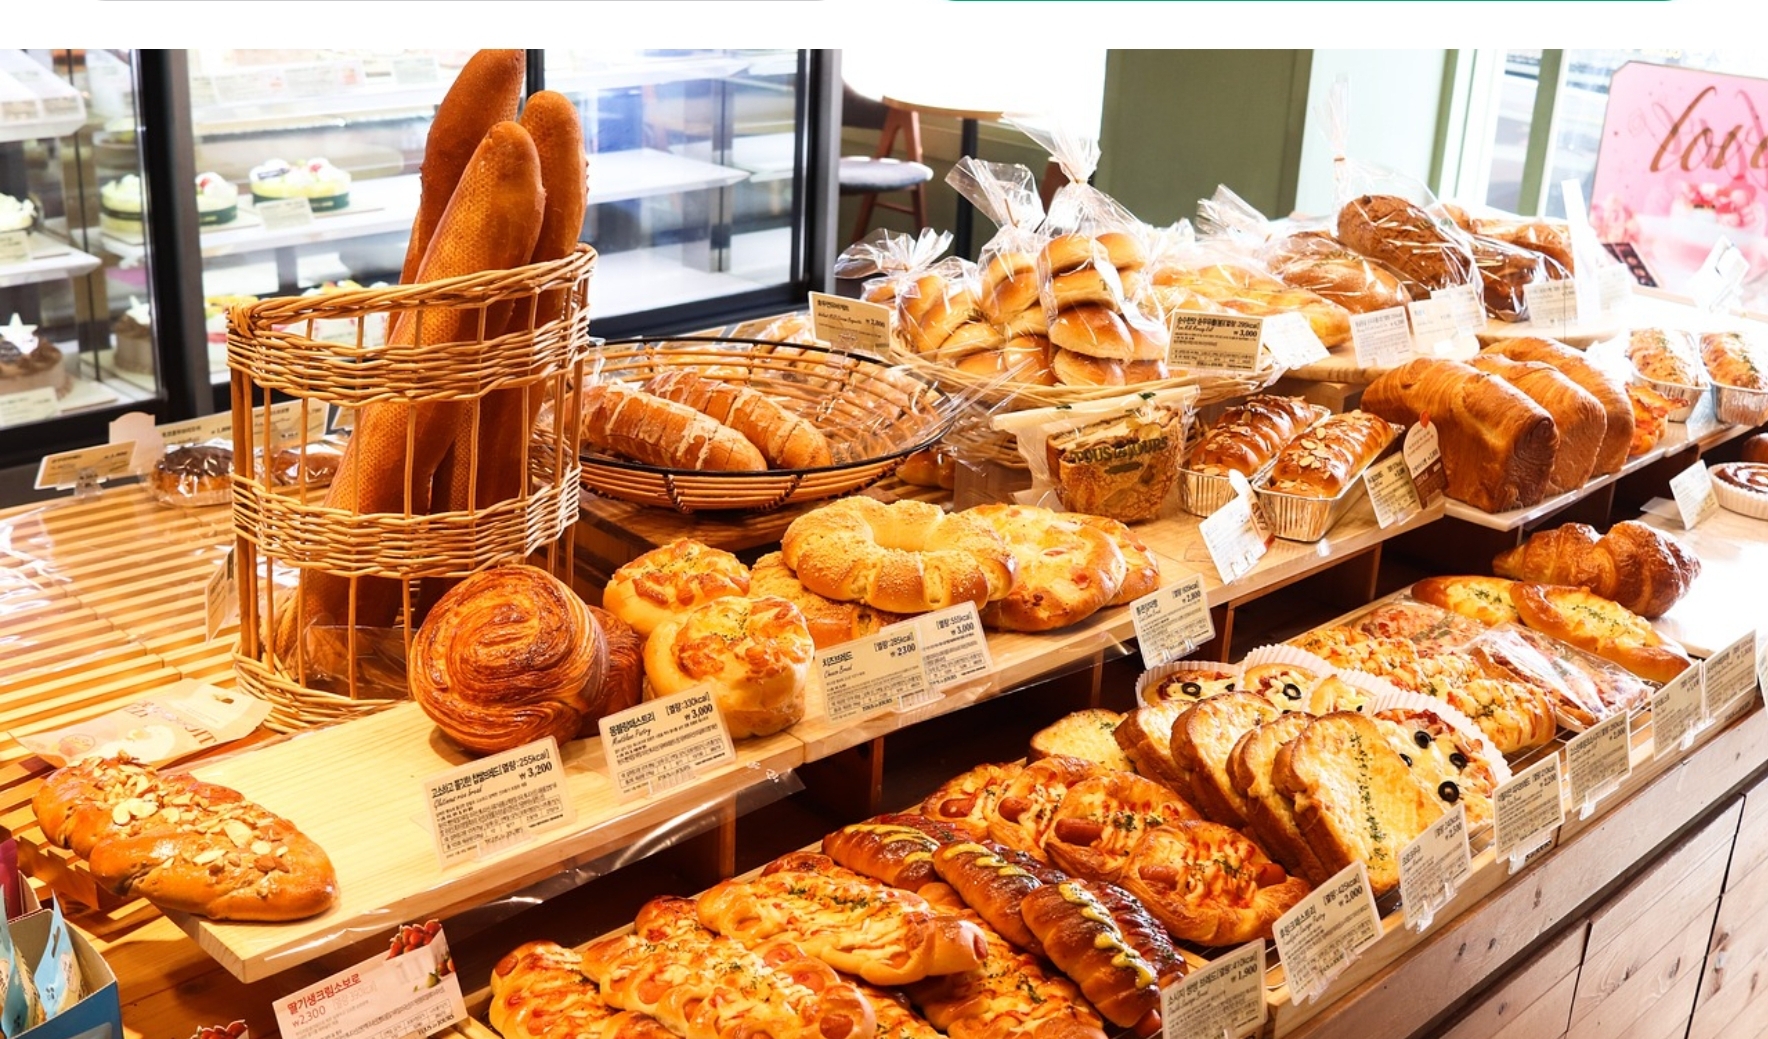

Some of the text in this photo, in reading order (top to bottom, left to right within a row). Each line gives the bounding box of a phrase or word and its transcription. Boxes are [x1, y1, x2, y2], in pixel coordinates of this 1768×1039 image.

[957, 622, 974, 635] 3,000
[692, 703, 713, 719] 3,000
[527, 761, 553, 779] 3,200
[431, 782, 454, 798] 고소하고
[454, 775, 472, 791] 쫄깃한
[1345, 885, 1363, 904] 2,000
[1238, 964, 1257, 981] 1,900
[287, 973, 361, 1015] 딸기생크림소보로
